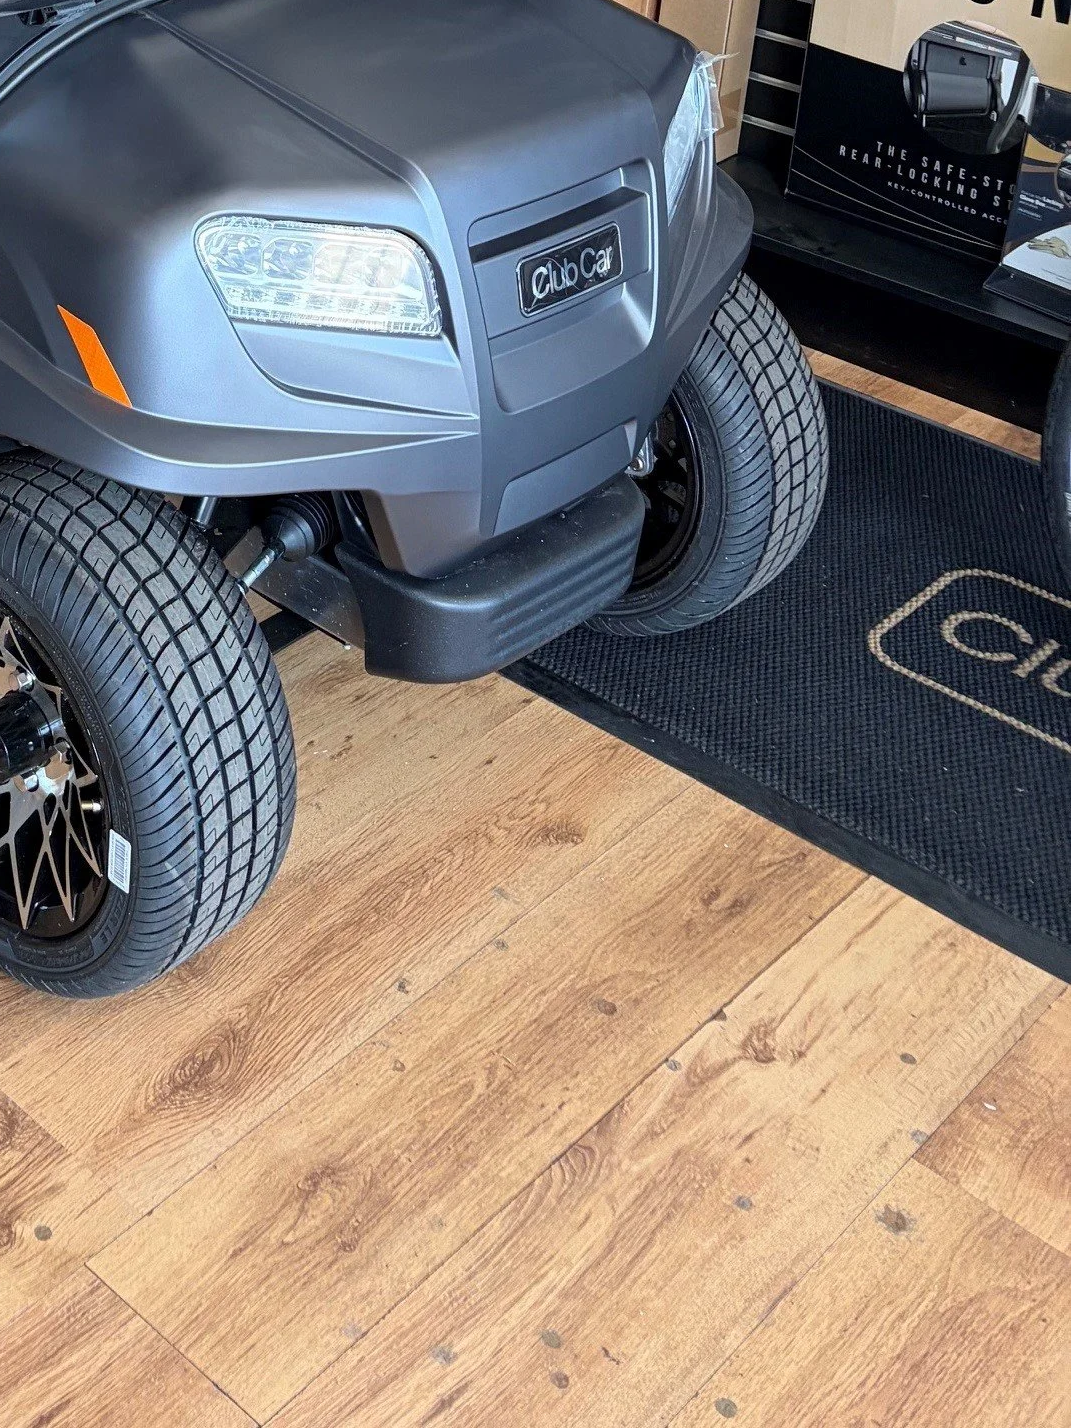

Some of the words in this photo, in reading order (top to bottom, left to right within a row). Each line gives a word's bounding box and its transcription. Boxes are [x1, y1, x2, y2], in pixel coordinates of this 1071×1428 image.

[839, 144, 978, 200] REAR-LOCKING
[876, 141, 908, 161] THE
[921, 155, 1015, 195] SAFE-STO
[887, 180, 977, 215] KEY-CONTROLLED
[531, 258, 578, 299] Club
[580, 245, 613, 278] Car
